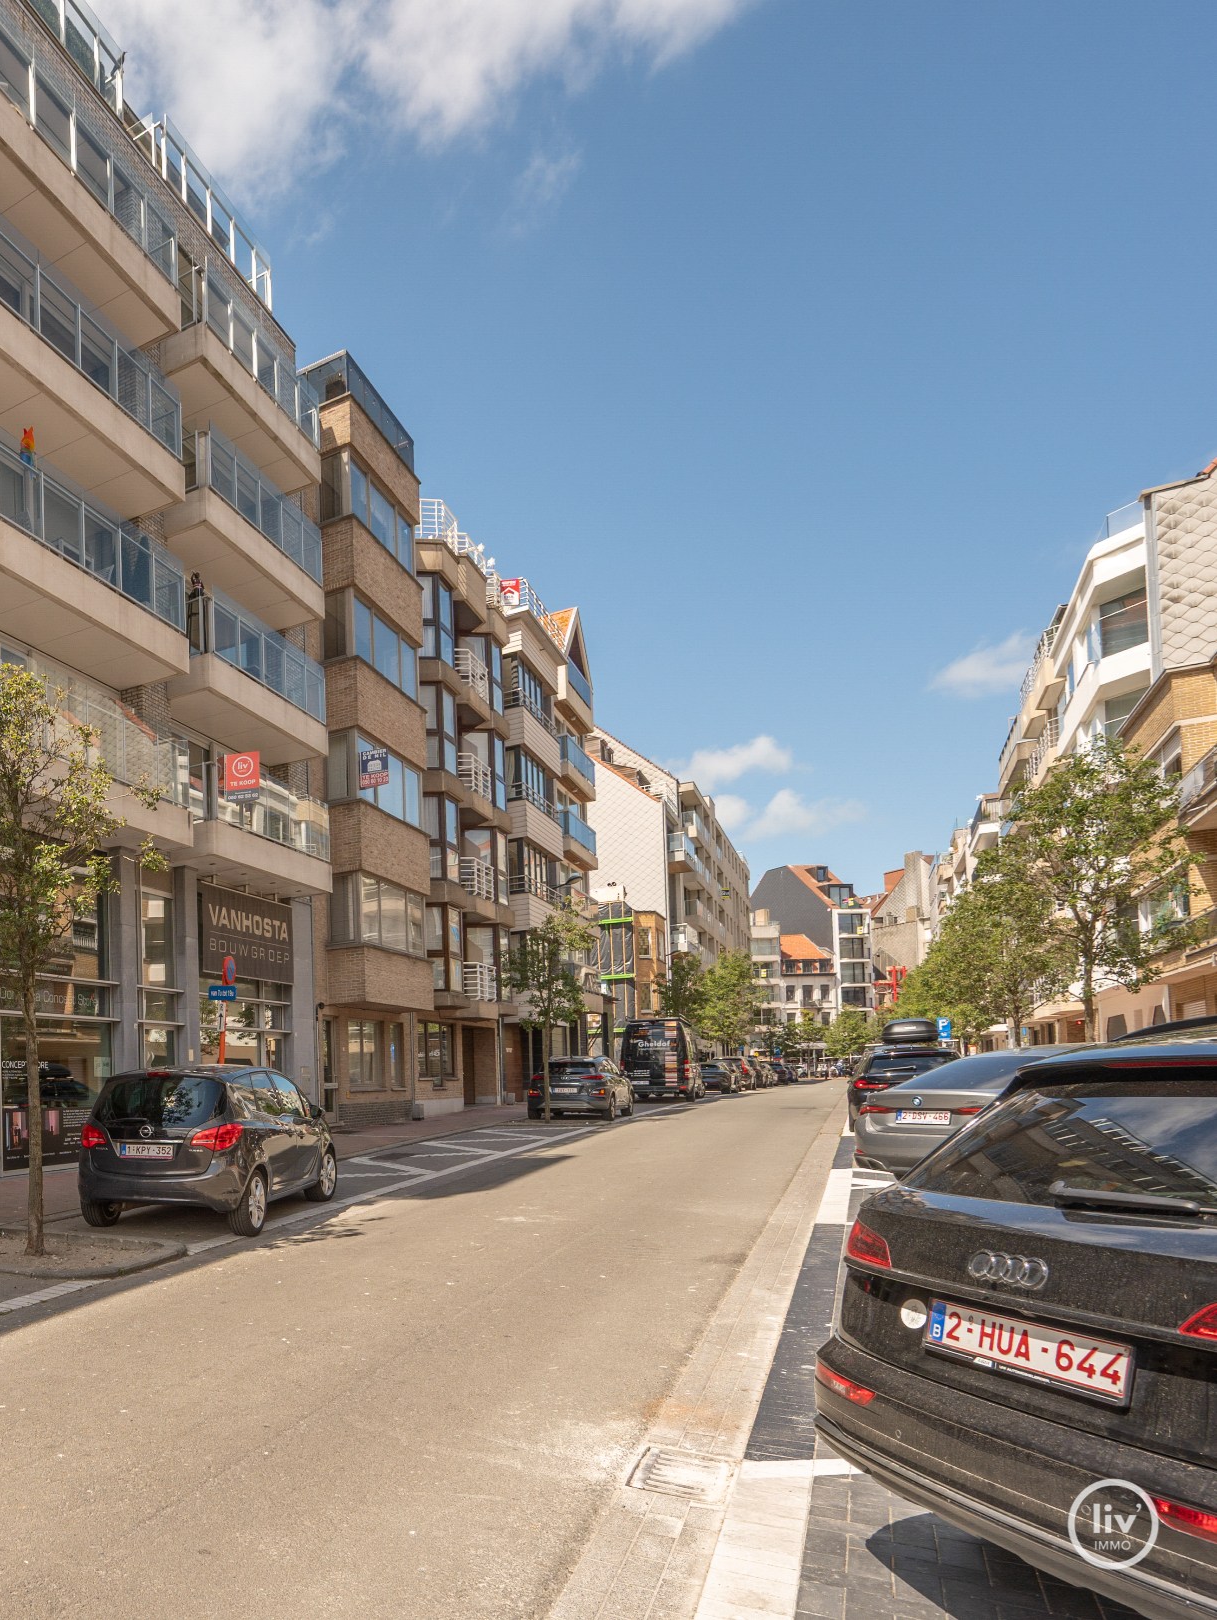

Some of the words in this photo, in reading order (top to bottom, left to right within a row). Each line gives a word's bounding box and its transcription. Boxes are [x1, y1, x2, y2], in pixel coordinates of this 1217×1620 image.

[362, 748, 387, 756] CAMBIER
[208, 903, 289, 942] VANHOSTA
[209, 938, 290, 965] BOUWGROEP
[902, 1111, 949, 1120] 2-DSV-466
[127, 1144, 172, 1155] 1-KPY-352
[932, 1324, 942, 1338] B
[946, 1311, 1124, 1385] 2-HUA-644
